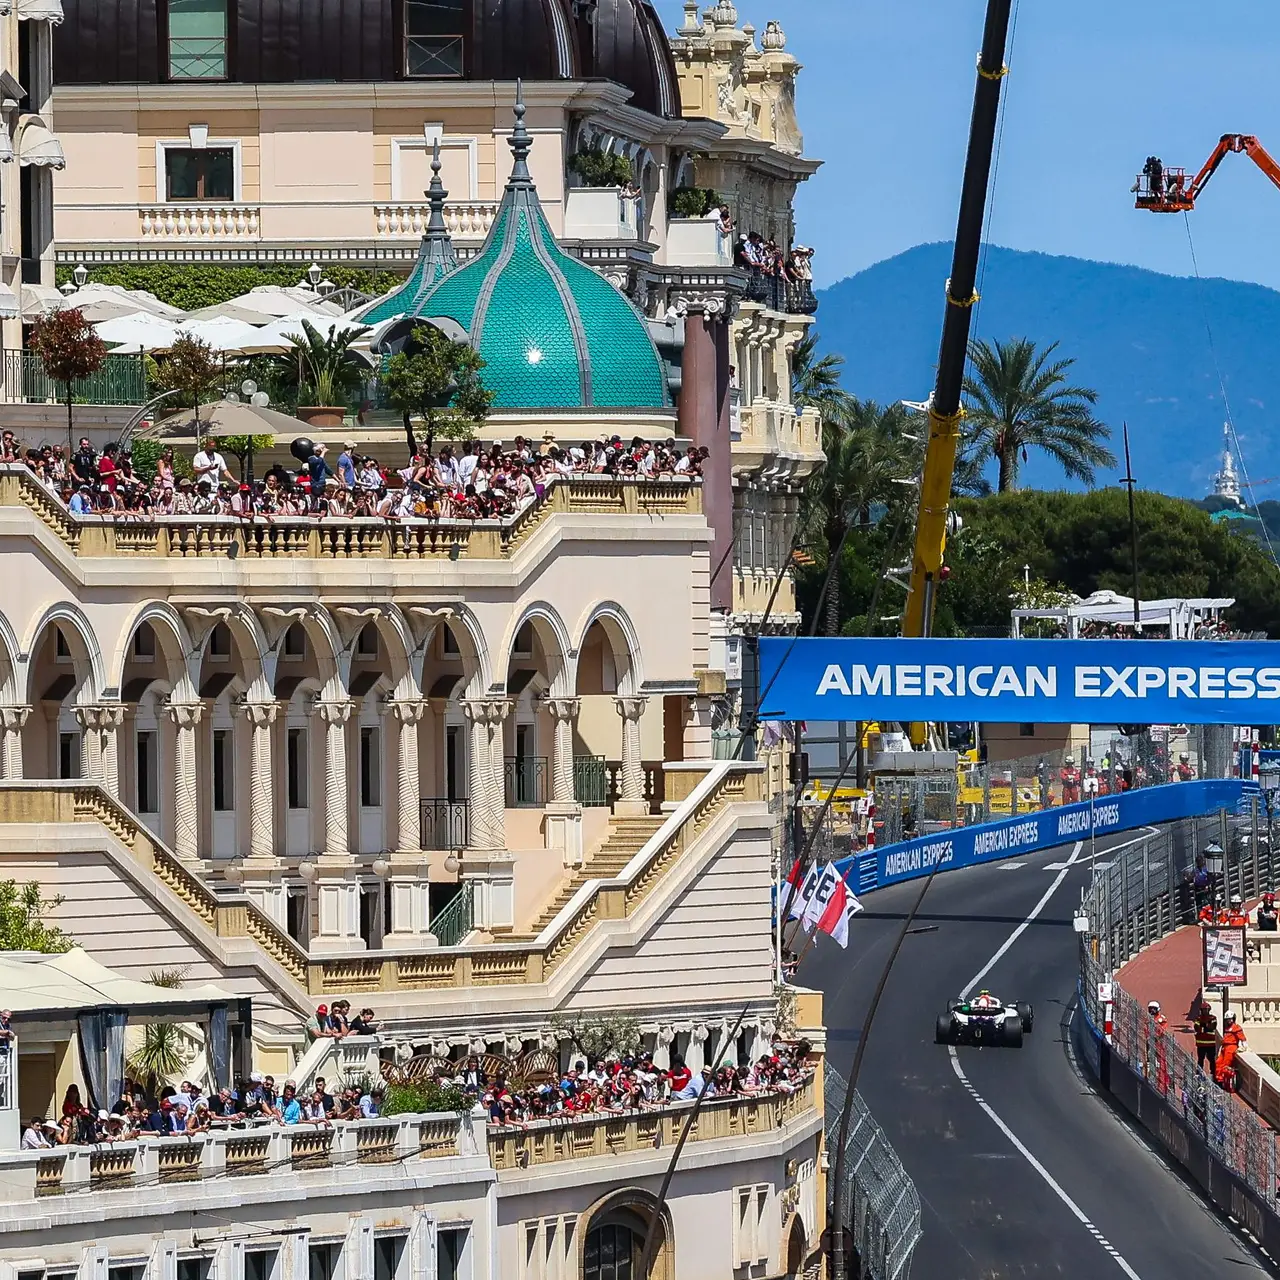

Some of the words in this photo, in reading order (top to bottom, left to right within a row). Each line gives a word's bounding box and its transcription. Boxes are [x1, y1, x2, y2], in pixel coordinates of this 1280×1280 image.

[816, 664, 1057, 698] AMERICAN
[1057, 811, 1090, 836] AMERICAN
[1091, 804, 1119, 829] EXPRESS
[973, 829, 1009, 855] AMERICAN
[1009, 822, 1038, 848] EXPRESS
[885, 849, 921, 876] AMERICAN
[922, 841, 953, 868] EXPRESS
